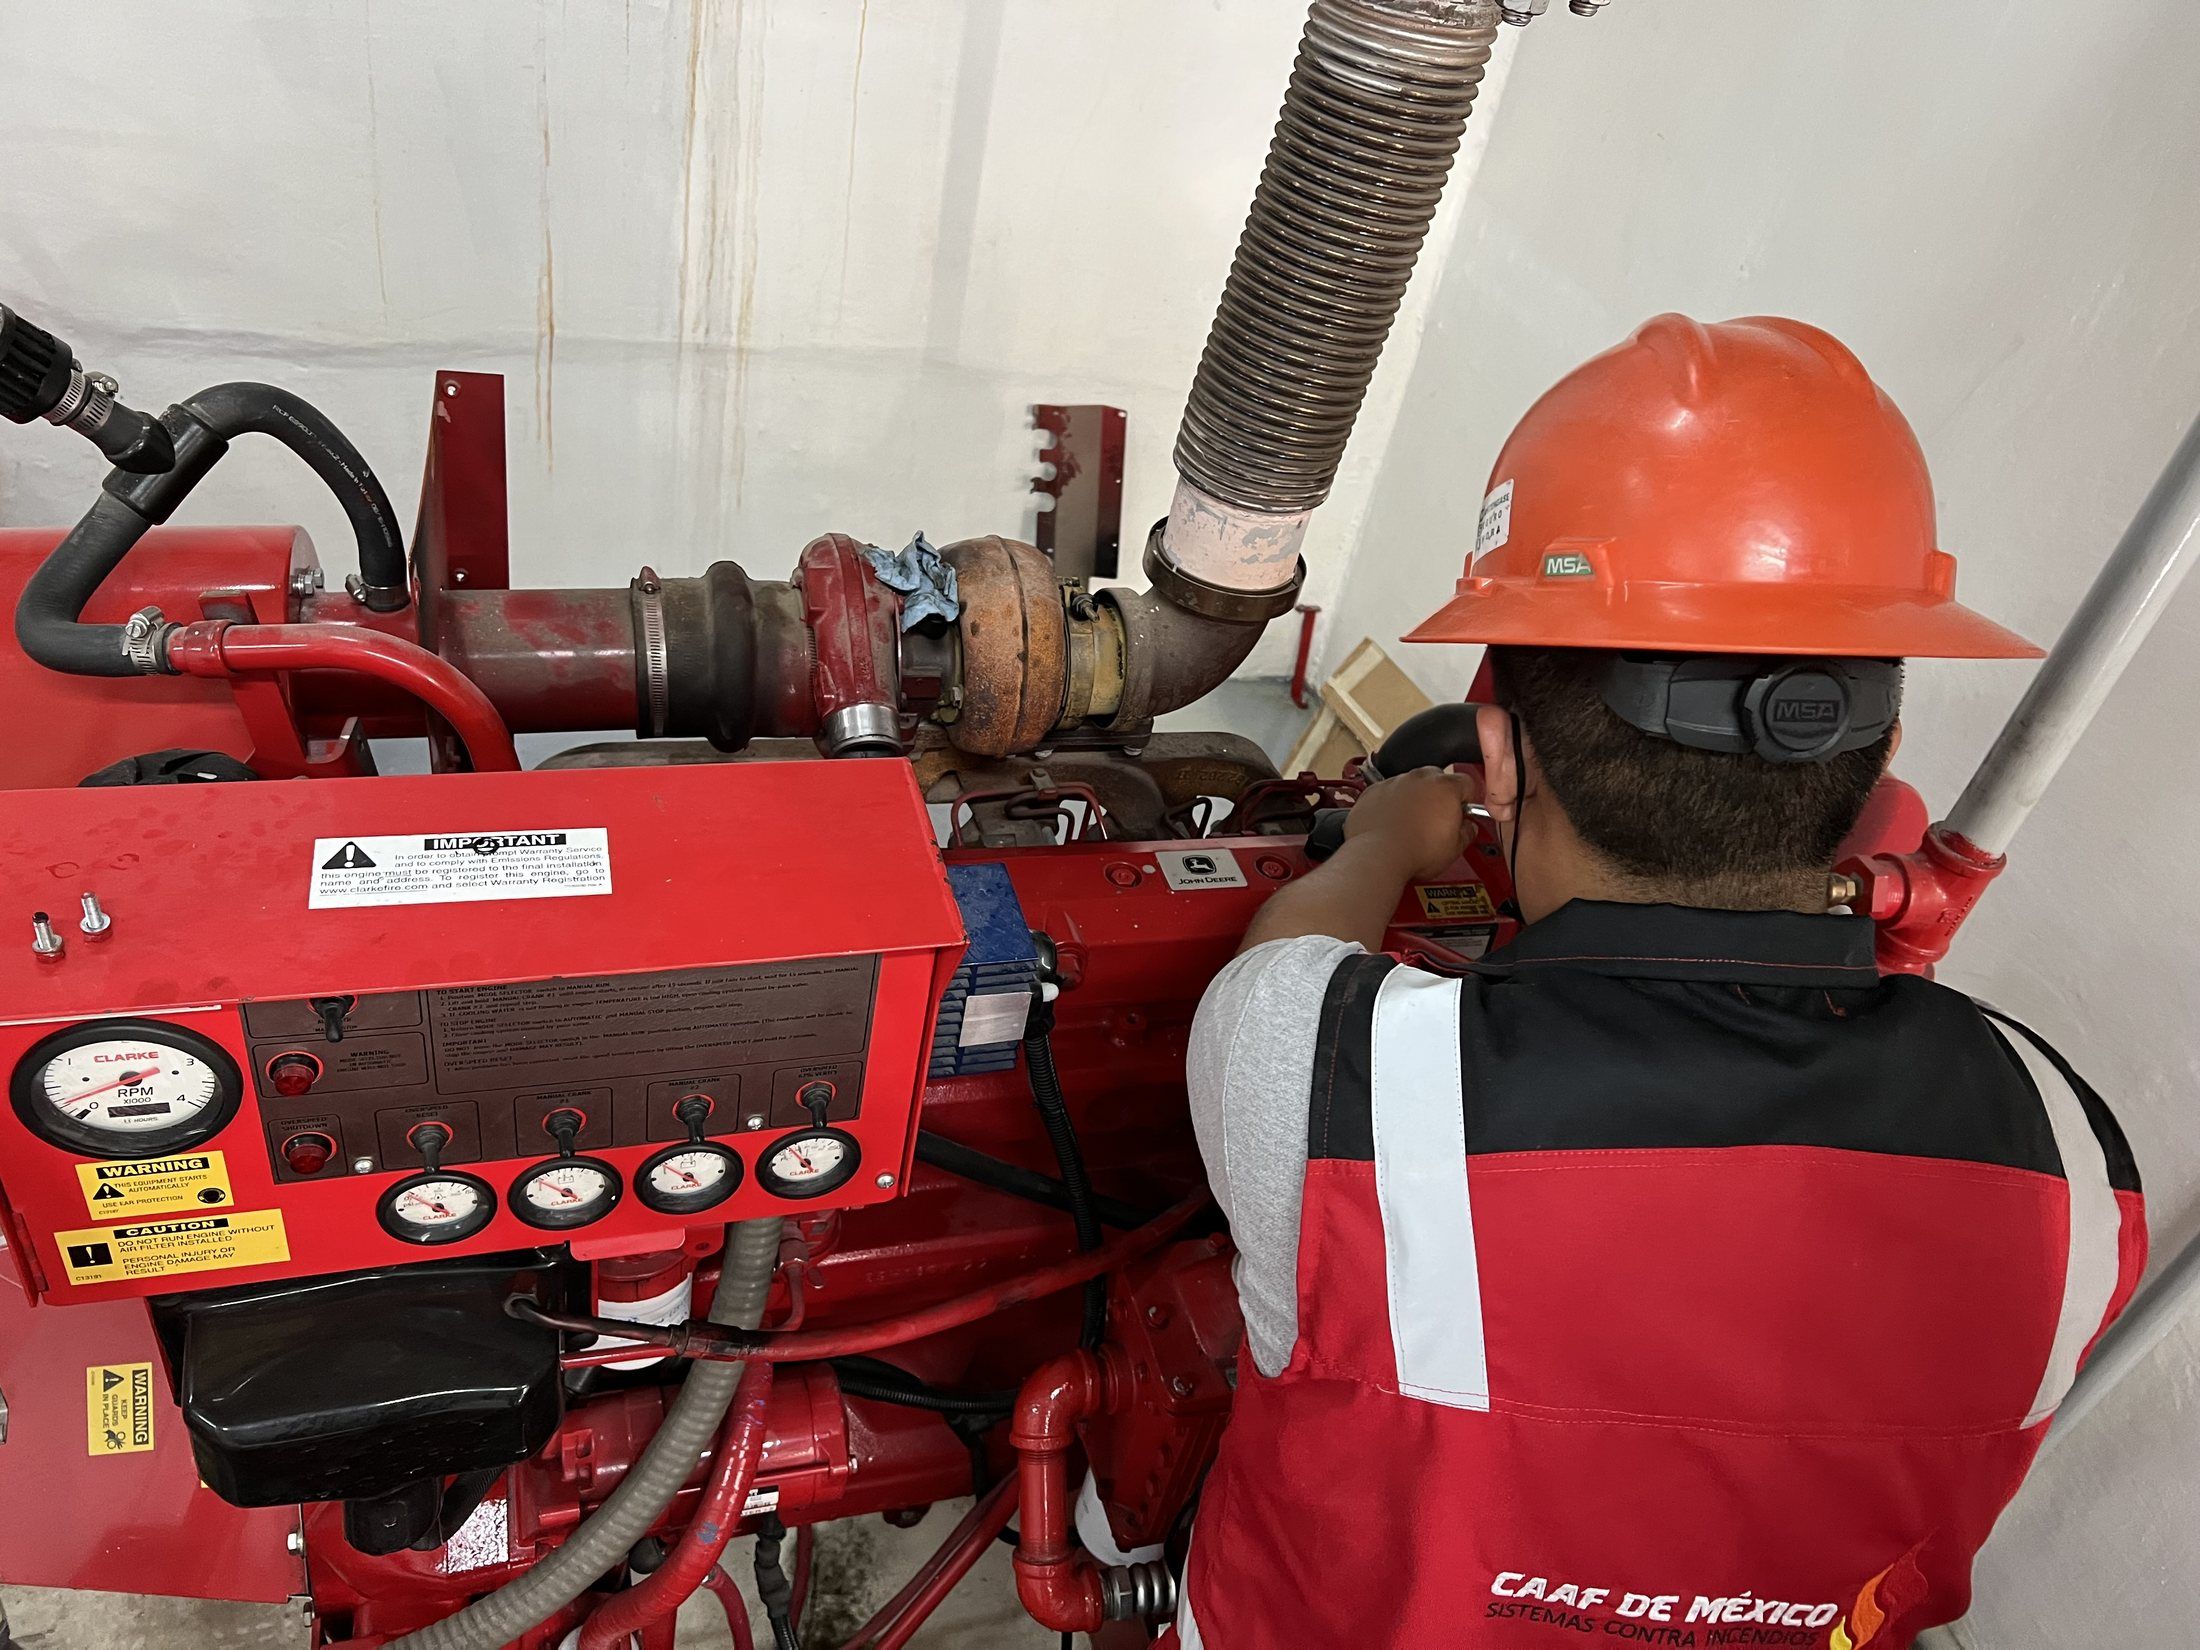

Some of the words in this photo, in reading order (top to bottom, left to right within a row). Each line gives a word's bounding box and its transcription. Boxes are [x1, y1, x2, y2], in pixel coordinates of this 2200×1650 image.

[1547, 556, 1592, 575] MSA
[1777, 701, 1834, 720] MSA
[408, 852, 432, 861] order
[519, 846, 563, 857] Warranty
[429, 858, 466, 868] comply
[468, 857, 489, 865] with
[491, 855, 541, 864] Emissions
[344, 871, 382, 881] engine
[385, 868, 412, 876] must
[415, 867, 428, 875] be
[432, 864, 486, 876] registered
[501, 862, 519, 870] the
[522, 861, 543, 869] final
[546, 859, 602, 868] installation
[359, 877, 381, 885] and
[459, 872, 499, 881] register
[506, 870, 524, 878] this
[576, 868, 590, 877] go
[432, 881, 452, 889] and
[455, 879, 488, 888] select
[490, 876, 539, 886] Warranty
[542, 873, 606, 884] Registration
[1178, 877, 1205, 885] JOHN
[1205, 875, 1238, 883] DEERE
[94, 1051, 159, 1063] CLARKE
[186, 1058, 195, 1067] 3
[117, 1086, 154, 1098] RPM
[176, 1094, 186, 1102] 4
[89, 1102, 99, 1110] 0
[123, 1097, 152, 1105] X1000
[102, 1160, 205, 1178] WARNING
[128, 1182, 190, 1193] AUTOMATICALLY
[133, 1178, 176, 1187] EQUIPMENT
[179, 1173, 208, 1182] STARTS
[136, 1195, 184, 1205] PROTECTION
[118, 1240, 133, 1248] DO
[136, 1238, 158, 1246] NOT
[161, 1235, 184, 1243] RUN
[187, 1231, 226, 1241] ENGINE
[228, 1225, 275, 1236] WITHOUT
[126, 1220, 215, 1238] CAUTION
[120, 1245, 138, 1253] AIR
[140, 1241, 175, 1251] FILTER
[177, 1236, 233, 1247] INSTALLED
[122, 1253, 178, 1264] PERSONAL
[180, 1248, 219, 1259] INJURY
[220, 1246, 236, 1254] OR
[124, 1260, 164, 1270] ENGINE
[166, 1255, 211, 1266] DAMAGE
[212, 1252, 235, 1260] MAY
[125, 1265, 165, 1276] RESULT
[103, 1393, 109, 1401] IN
[134, 1371, 149, 1443] WARNING
[1490, 1571, 1610, 1610] CAAF
[1614, 1592, 1680, 1622] DE
[1684, 1590, 1838, 1628] MÉXICO
[1484, 1602, 1595, 1633] SISTEMAS
[1603, 1620, 1696, 1648] CONTRA
[1705, 1627, 1820, 1647] INCENDIOS
